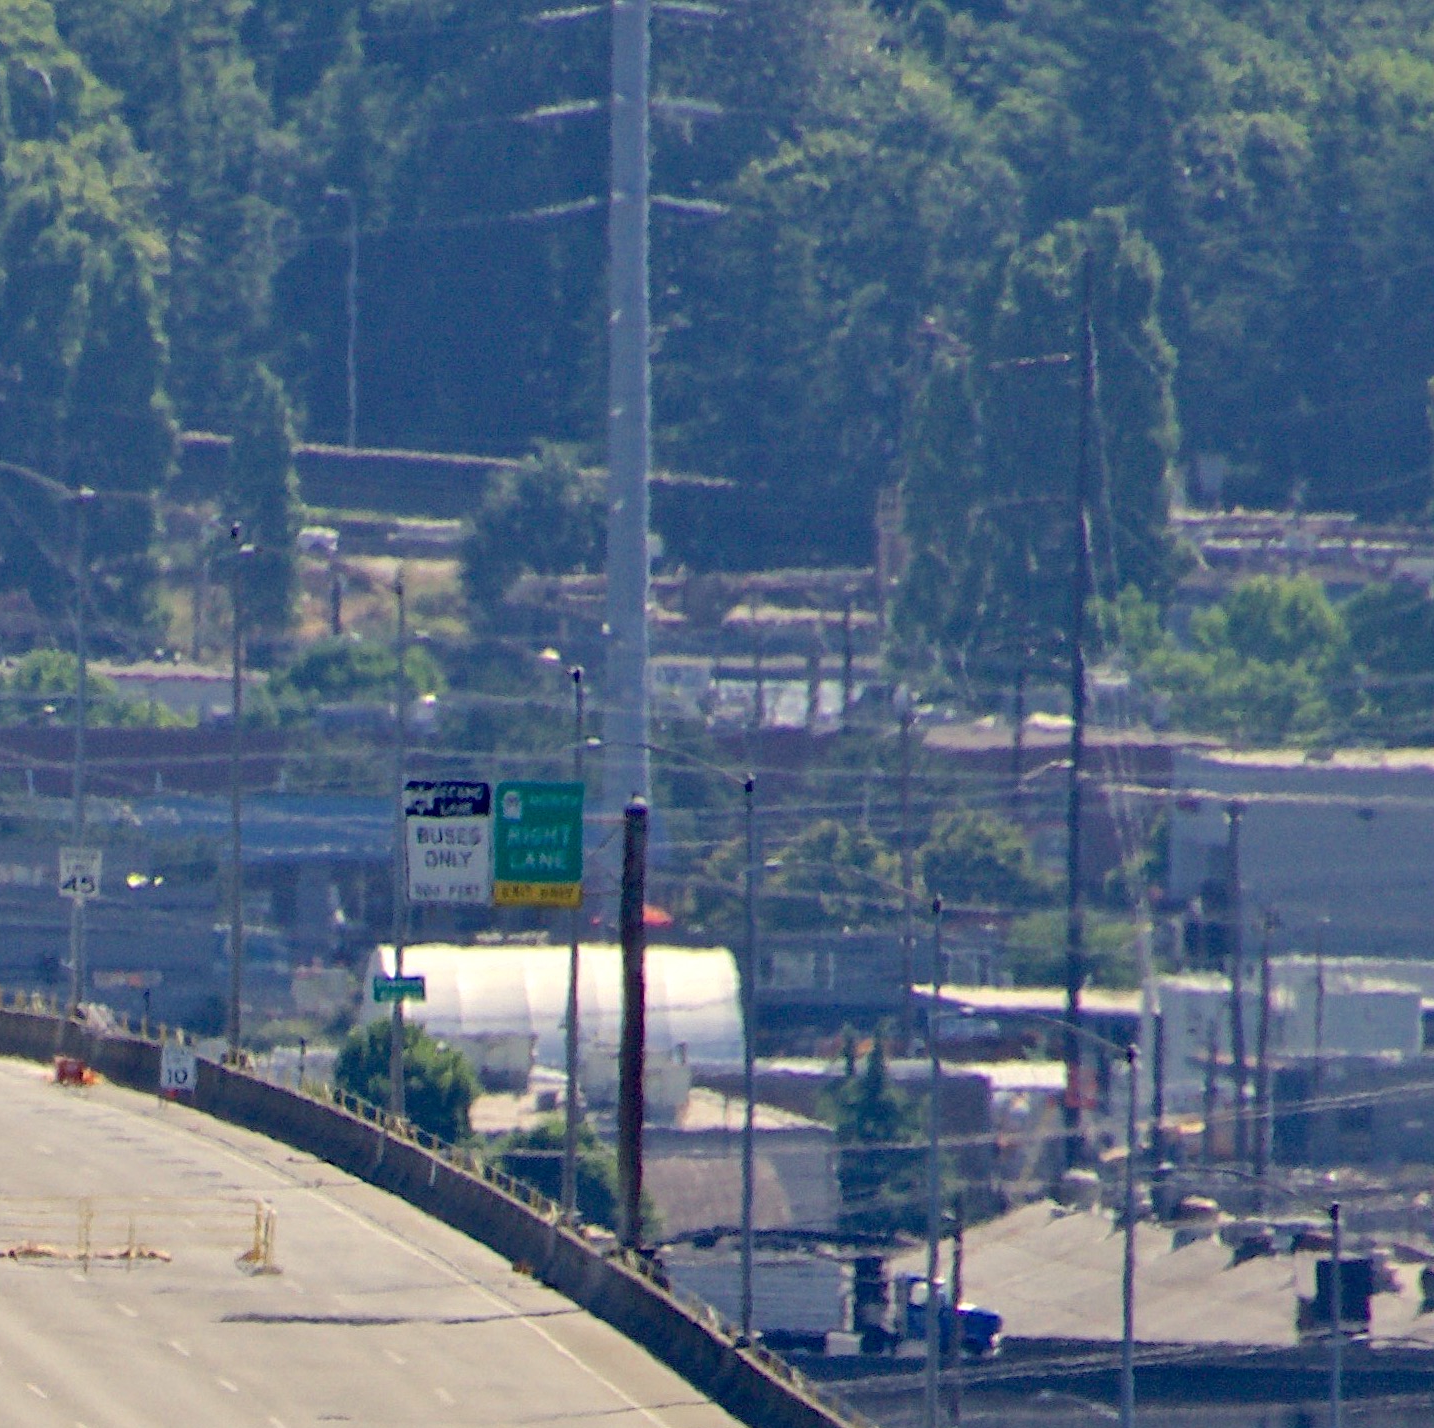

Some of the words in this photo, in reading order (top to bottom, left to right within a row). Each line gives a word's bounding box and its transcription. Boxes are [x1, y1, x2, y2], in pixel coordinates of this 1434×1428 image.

[417, 826, 482, 845] BUSES
[507, 826, 572, 846] RIGHT
[425, 850, 473, 869] ONLY
[510, 850, 569, 869] LANE
[62, 875, 95, 894] 45
[167, 1068, 188, 1084] 10
